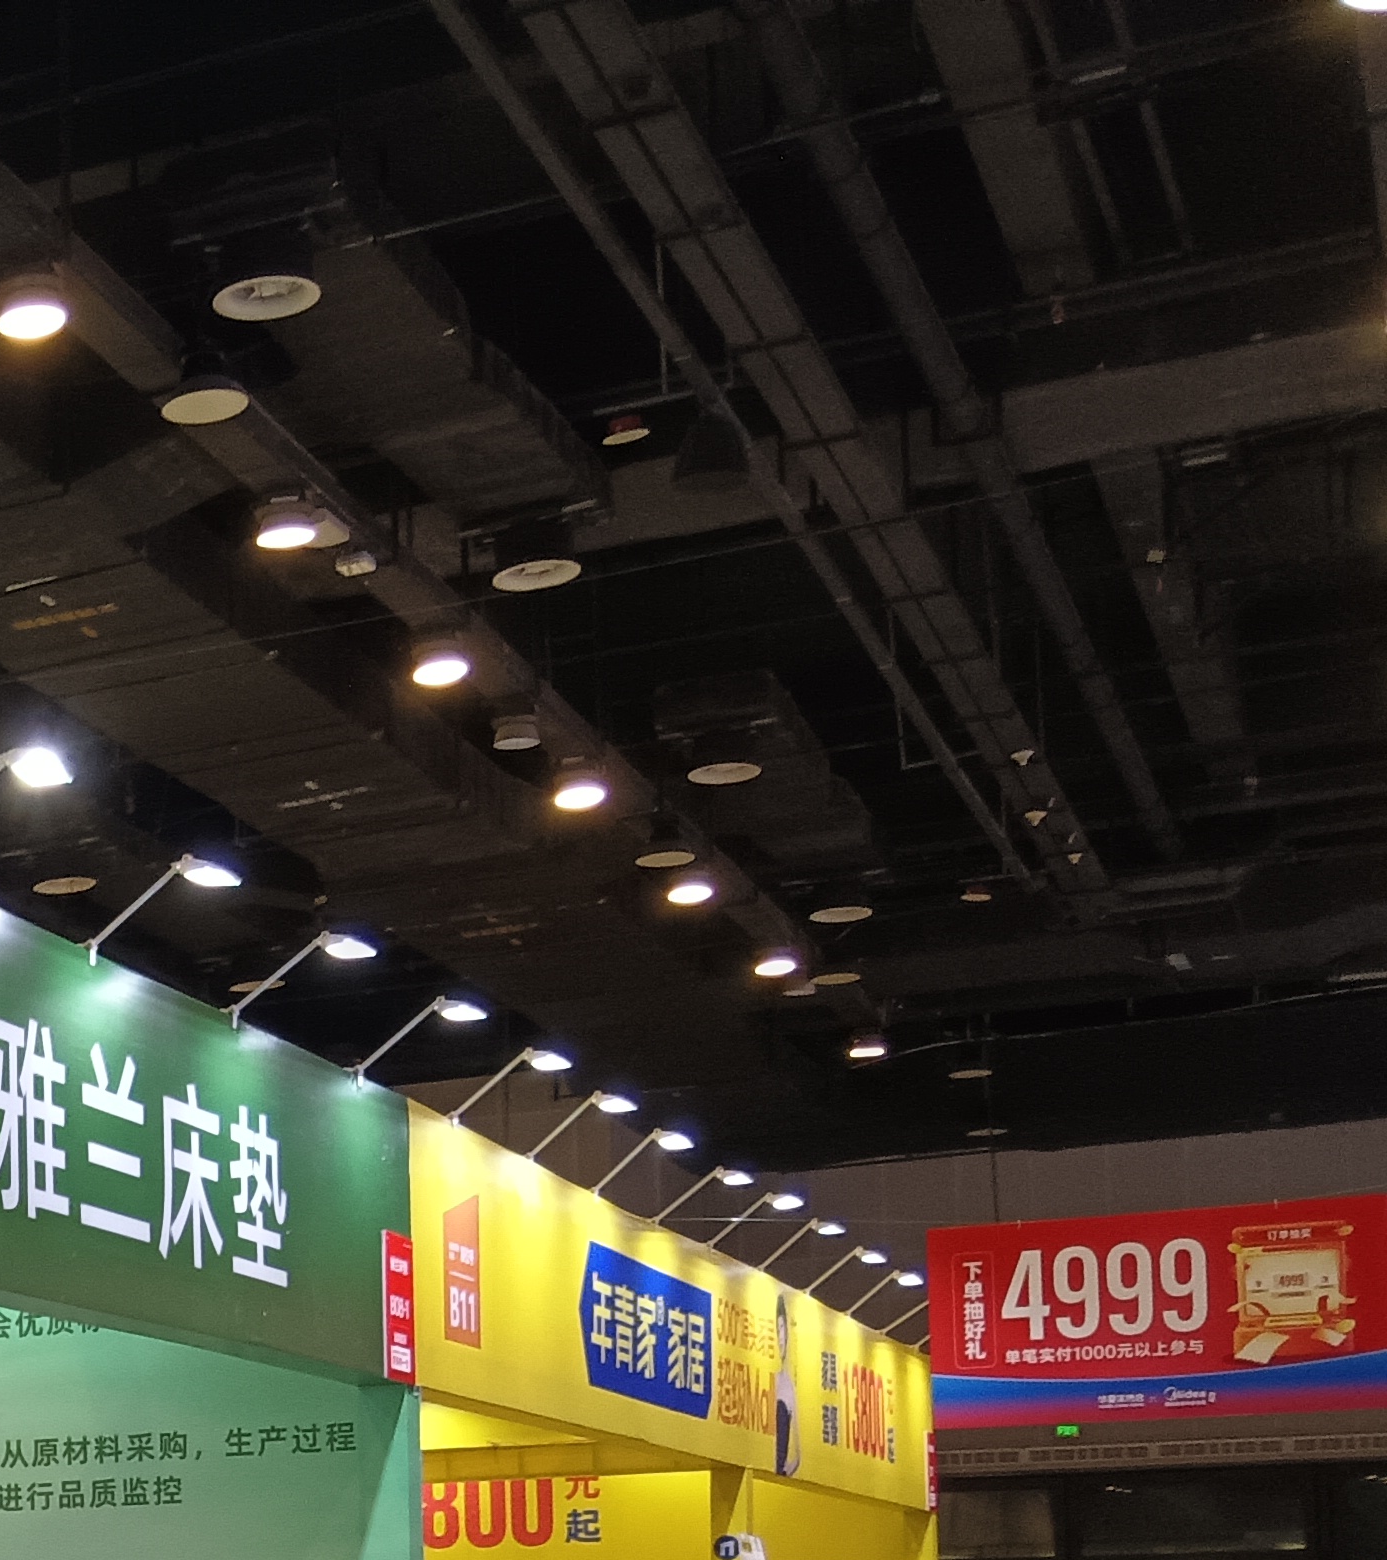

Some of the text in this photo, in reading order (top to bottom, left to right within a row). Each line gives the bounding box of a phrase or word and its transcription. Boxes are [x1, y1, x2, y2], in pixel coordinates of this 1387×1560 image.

[449, 1285, 476, 1333] B11
[962, 1261, 987, 1361] 下单抽好礼
[1000, 1238, 1209, 1341] 4999
[1004, 1340, 1205, 1365] 单笔实付1000元以上参与
